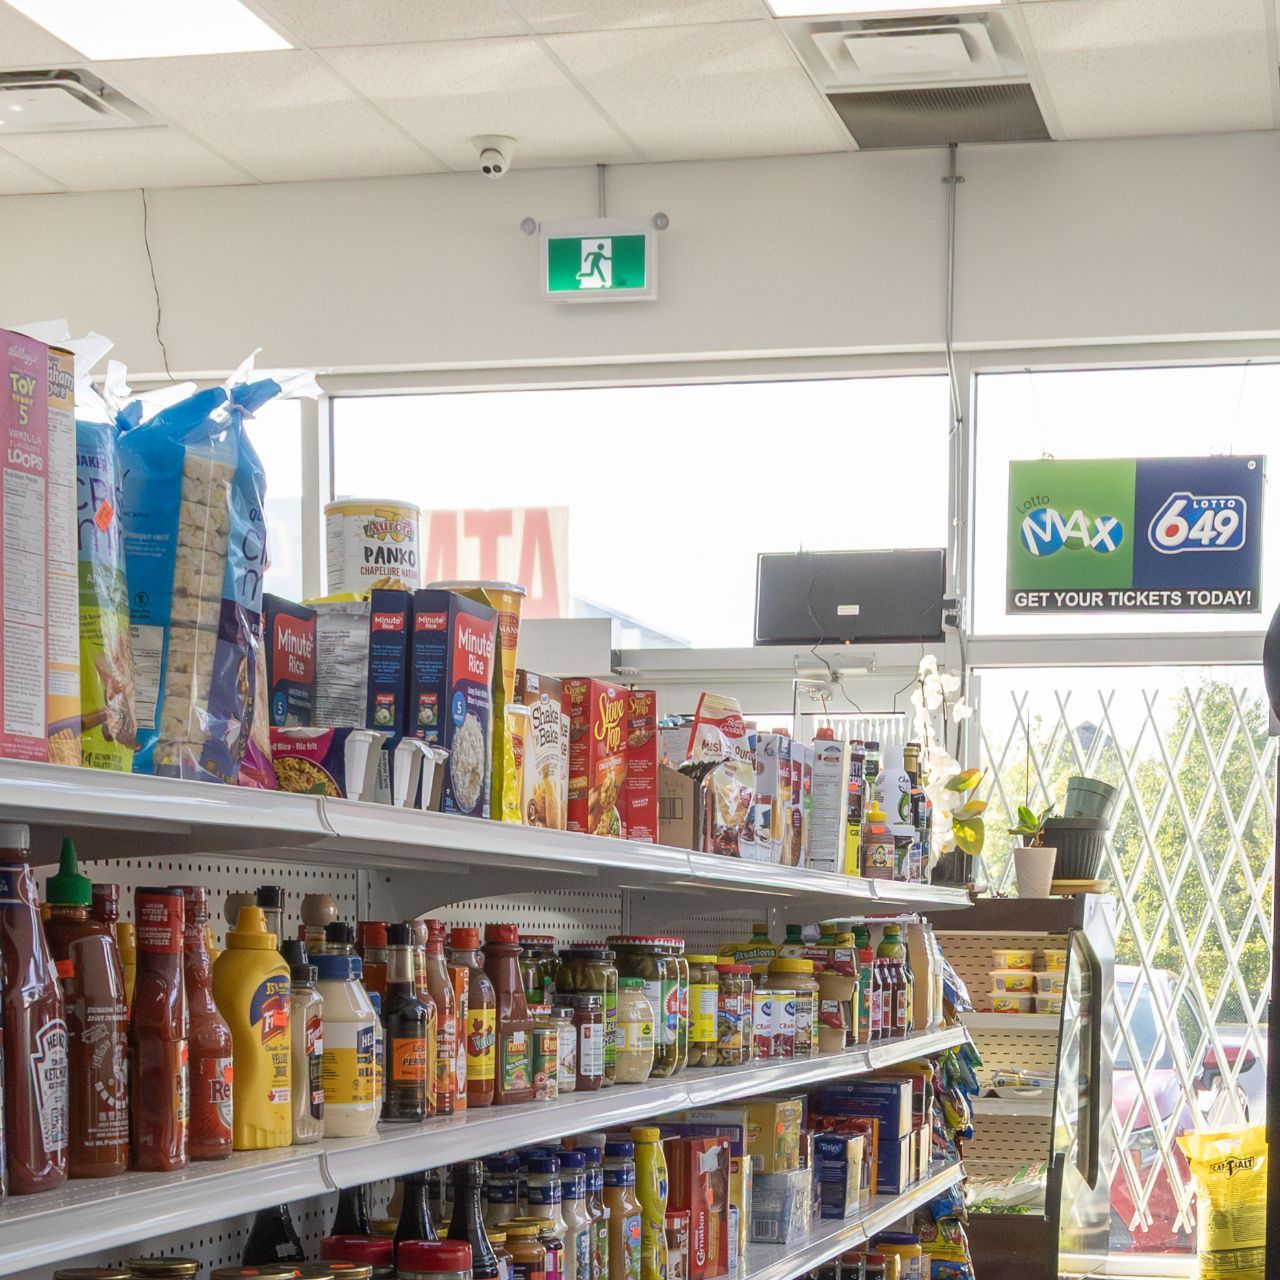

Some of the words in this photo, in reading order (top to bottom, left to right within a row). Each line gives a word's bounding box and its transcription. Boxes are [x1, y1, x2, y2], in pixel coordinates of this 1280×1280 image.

[9, 371, 36, 394] TOY
[7, 448, 43, 472] LOOPS
[1192, 499, 1235, 509] LOTTO
[1022, 508, 1118, 555] MAX
[364, 546, 416, 565] PANKO
[360, 566, 400, 577] CHAPELURE
[1015, 592, 1049, 607] GET
[1054, 592, 1103, 607] YOUR
[1108, 591, 1182, 607] TICKETS
[1186, 590, 1251, 606] TODAY!
[277, 626, 313, 659] Minute
[458, 628, 493, 660] Minute
[288, 656, 305, 676] Rice
[469, 656, 484, 676] Rice
[532, 704, 559, 730] Shake
[595, 692, 624, 741] Stove
[277, 742, 290, 750] Rice
[539, 726, 559, 748] Bake
[606, 722, 621, 754] Top
[46, 1031, 67, 1051] HEINZ
[695, 1211, 706, 1267] Carnation
